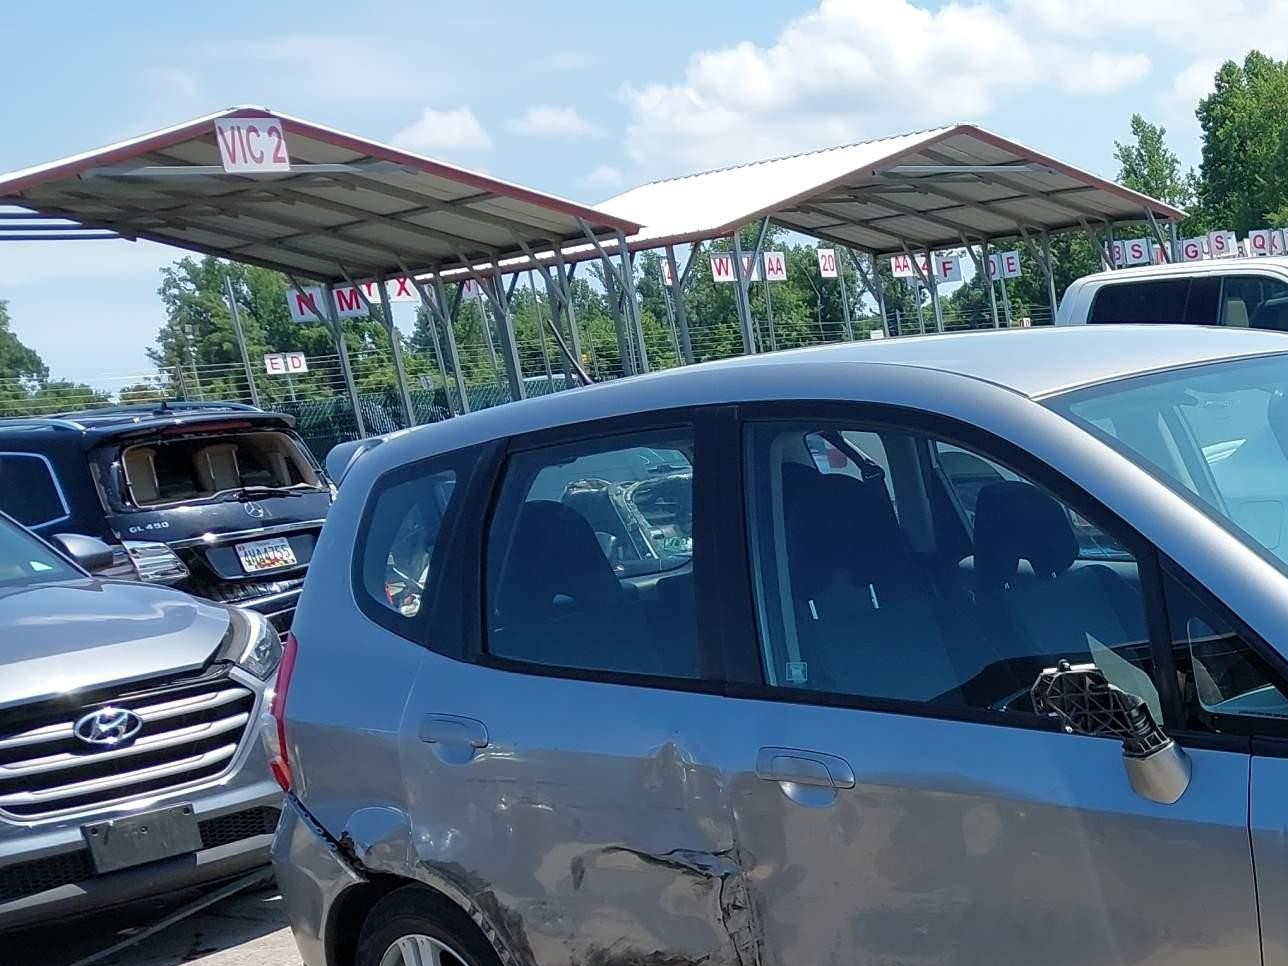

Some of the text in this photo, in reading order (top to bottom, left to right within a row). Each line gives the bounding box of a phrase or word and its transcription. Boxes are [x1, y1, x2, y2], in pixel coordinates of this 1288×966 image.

[217, 125, 287, 164] VIC 2
[1215, 235, 1224, 250] S
[1253, 234, 1266, 249] Q
[1131, 244, 1142, 259] S
[1185, 243, 1199, 259] G
[714, 257, 729, 276] W
[768, 257, 784, 275] AA
[821, 255, 835, 271] 20
[942, 261, 953, 278] F
[1007, 256, 1017, 272] E
[395, 276, 411, 296] X
[296, 293, 316, 316] N
[335, 287, 361, 311] M
[269, 357, 281, 370] E
[291, 356, 302, 369] D
[128, 526, 145, 534] GL
